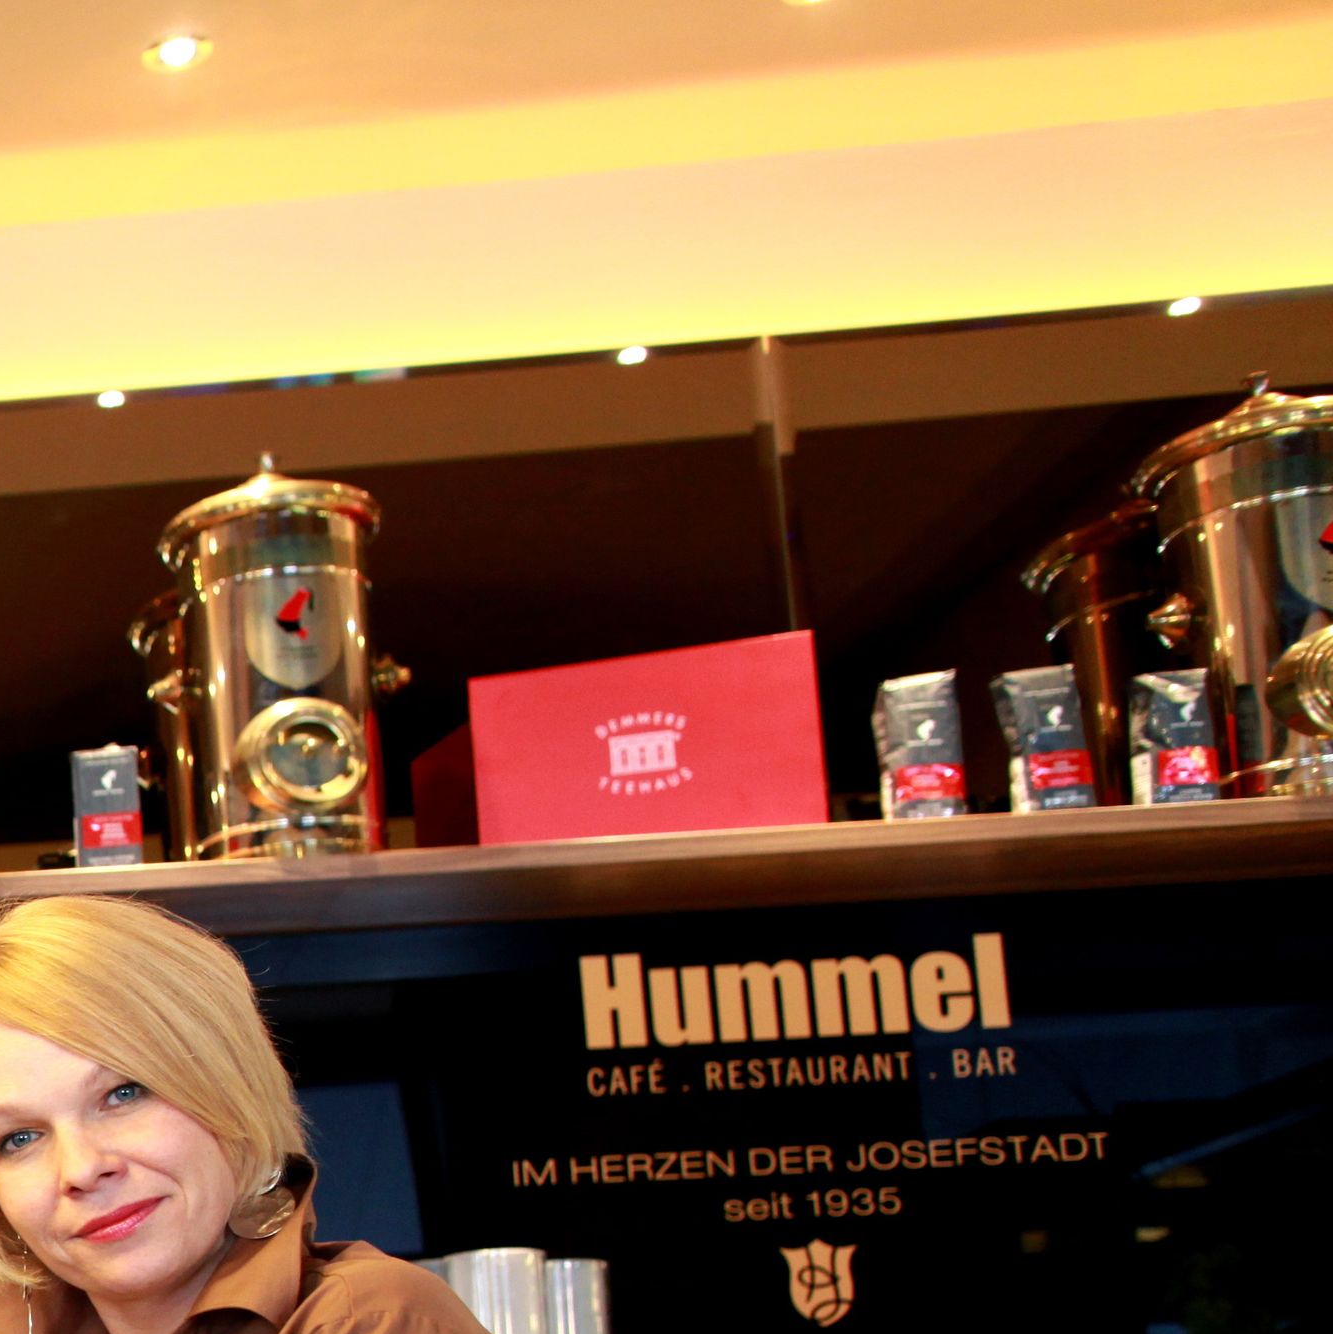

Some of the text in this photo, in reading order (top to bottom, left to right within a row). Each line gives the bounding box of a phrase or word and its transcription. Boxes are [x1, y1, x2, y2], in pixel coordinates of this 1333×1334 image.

[594, 711, 687, 740] DEMMERS
[598, 767, 693, 795] TEEHAUS
[579, 932, 1012, 1049] Hummel
[587, 1046, 1016, 1096] CAFÉ RESTAURANT BAR
[513, 1132, 1107, 1186] IM HERZEN DER JOSEFSTADT
[724, 1187, 902, 1221] seit 1935
